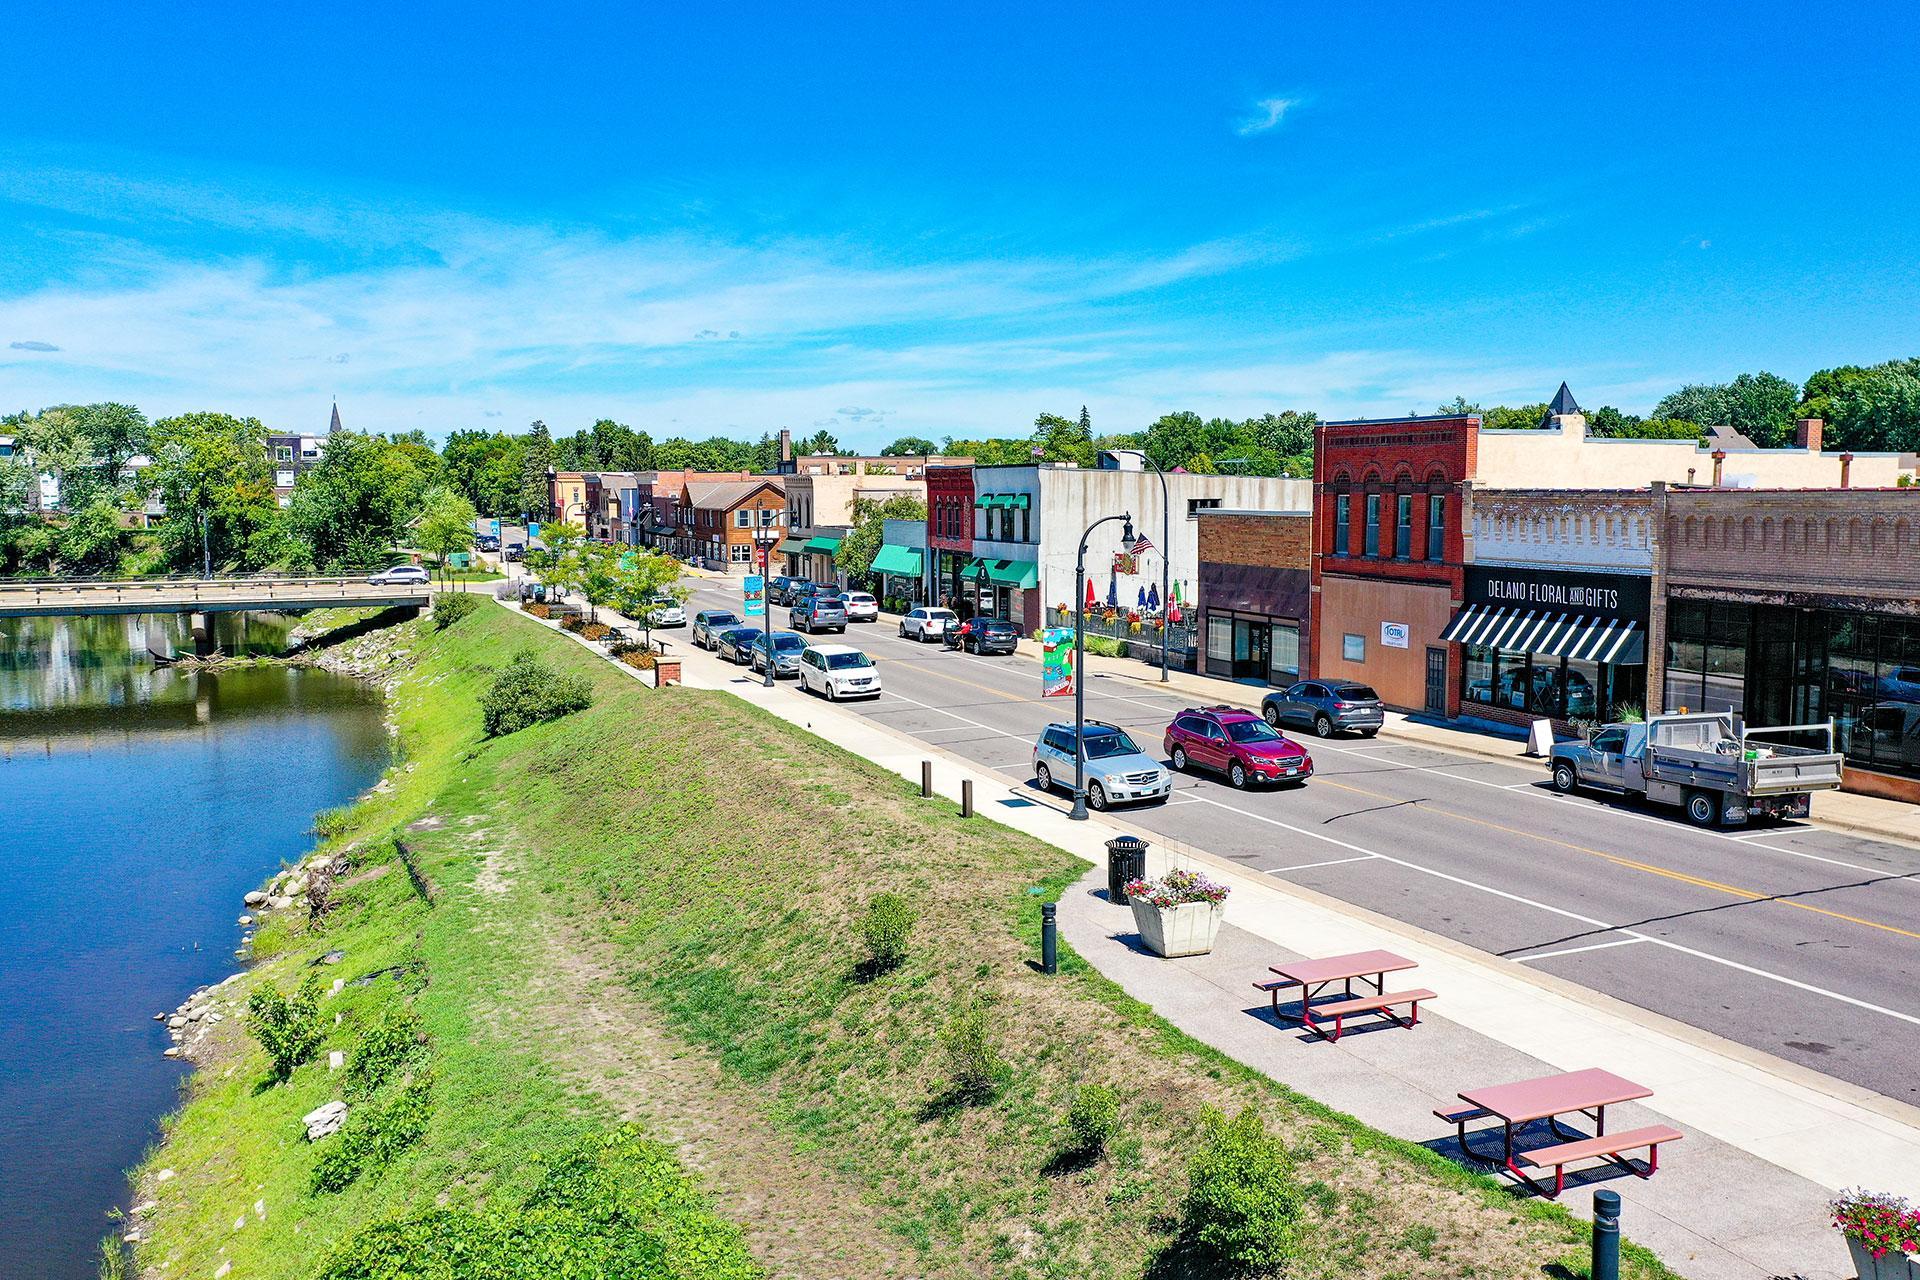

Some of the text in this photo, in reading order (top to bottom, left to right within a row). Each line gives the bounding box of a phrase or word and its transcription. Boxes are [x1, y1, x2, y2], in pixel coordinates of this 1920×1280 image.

[1488, 579, 1618, 609] DELANO FLORAL AND GIFTS
